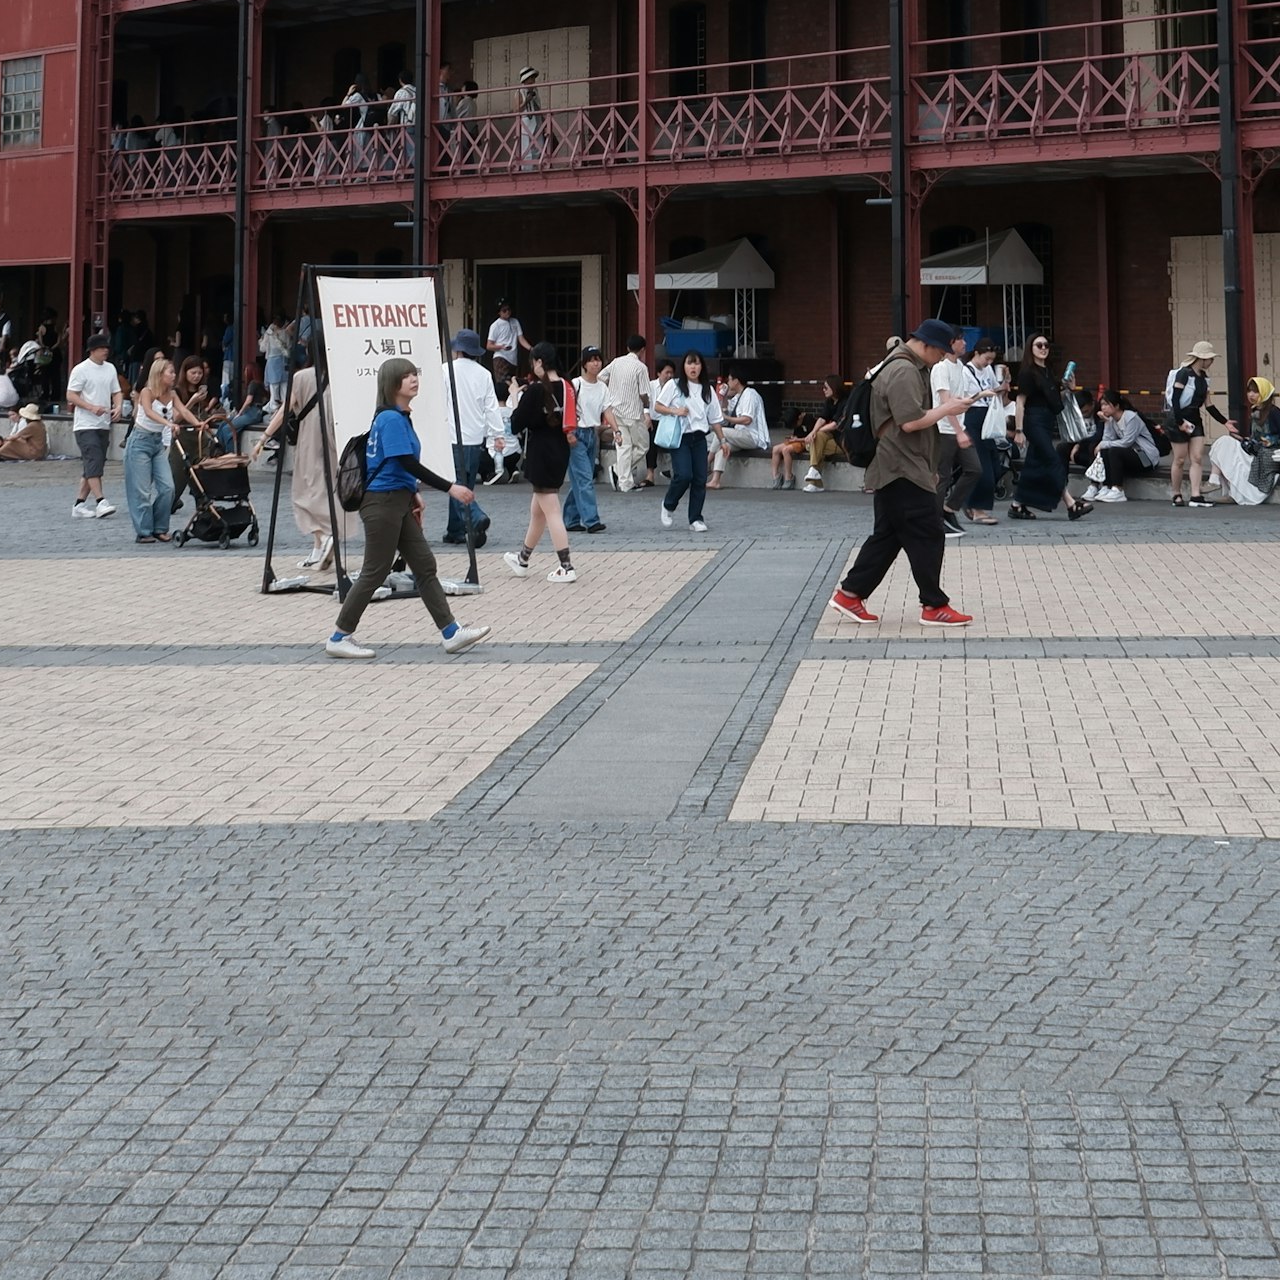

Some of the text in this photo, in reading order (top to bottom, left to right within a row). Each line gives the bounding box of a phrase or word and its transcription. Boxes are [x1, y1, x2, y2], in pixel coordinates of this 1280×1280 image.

[332, 304, 428, 328] ENTRANCE
[364, 339, 412, 355] 入場口
